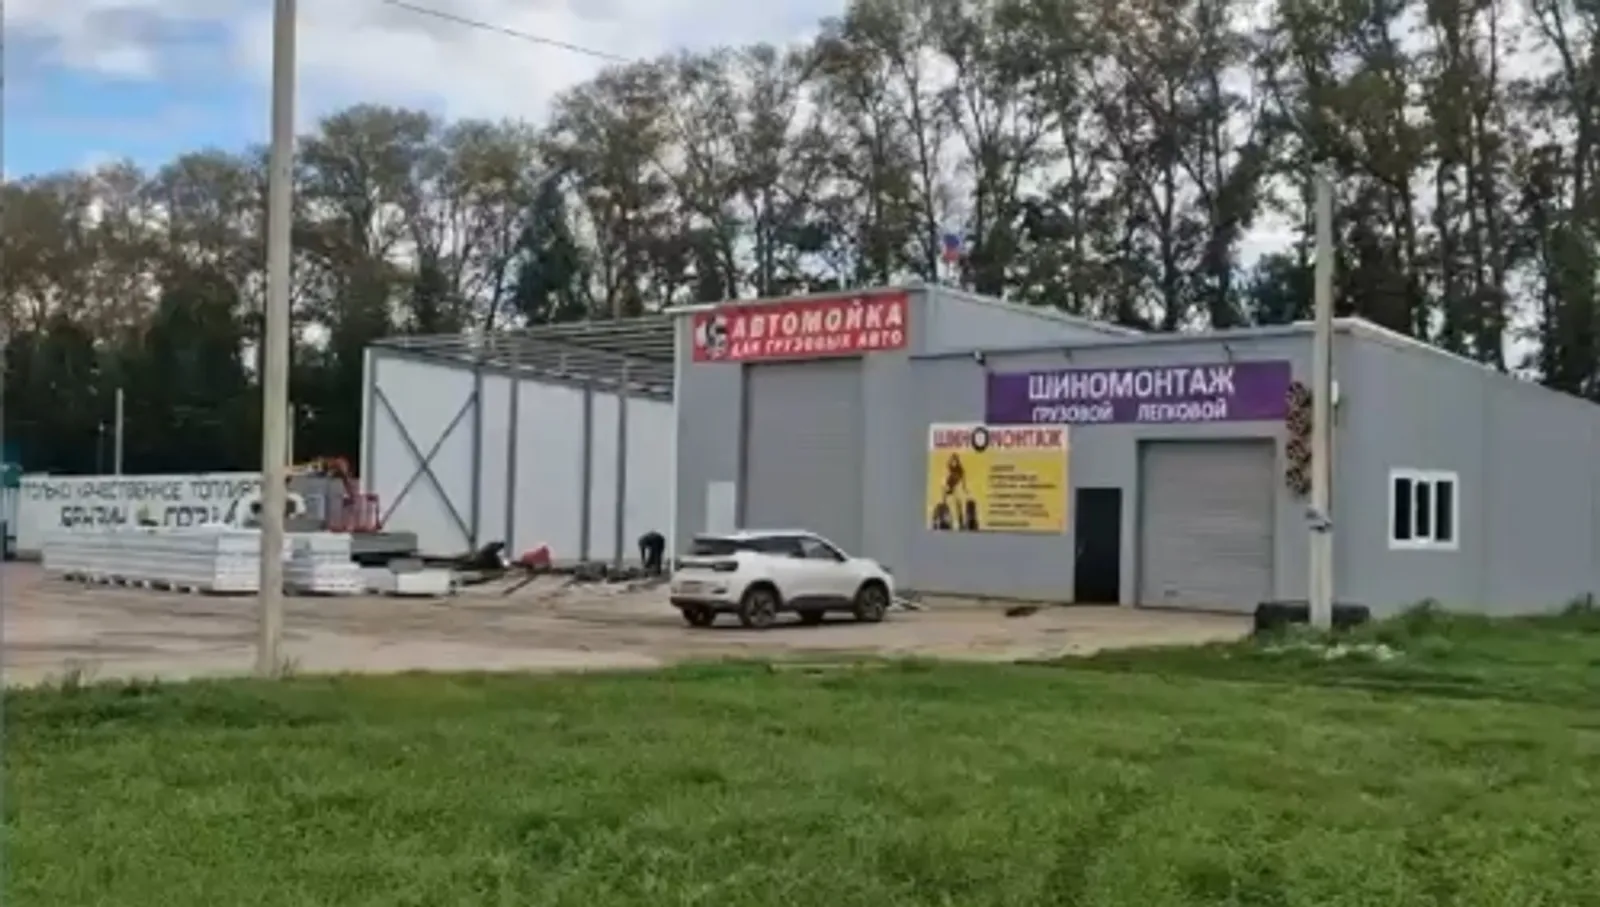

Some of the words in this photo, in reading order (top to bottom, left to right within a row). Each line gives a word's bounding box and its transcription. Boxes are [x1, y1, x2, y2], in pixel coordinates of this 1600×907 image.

[731, 299, 904, 339] АВТОМОЙКА
[731, 339, 762, 357] ДЛЯ
[766, 333, 852, 354] ГРУЗОВЫХ
[856, 329, 903, 348] АВТО
[1028, 366, 1236, 401] ШИНОМОНТАЖ
[1032, 400, 1114, 422] ГРУЗОВОЙ
[1135, 398, 1228, 421] ЛЕГКОВОЙ
[933, 427, 1063, 453] ШИНОМОНТАЖ
